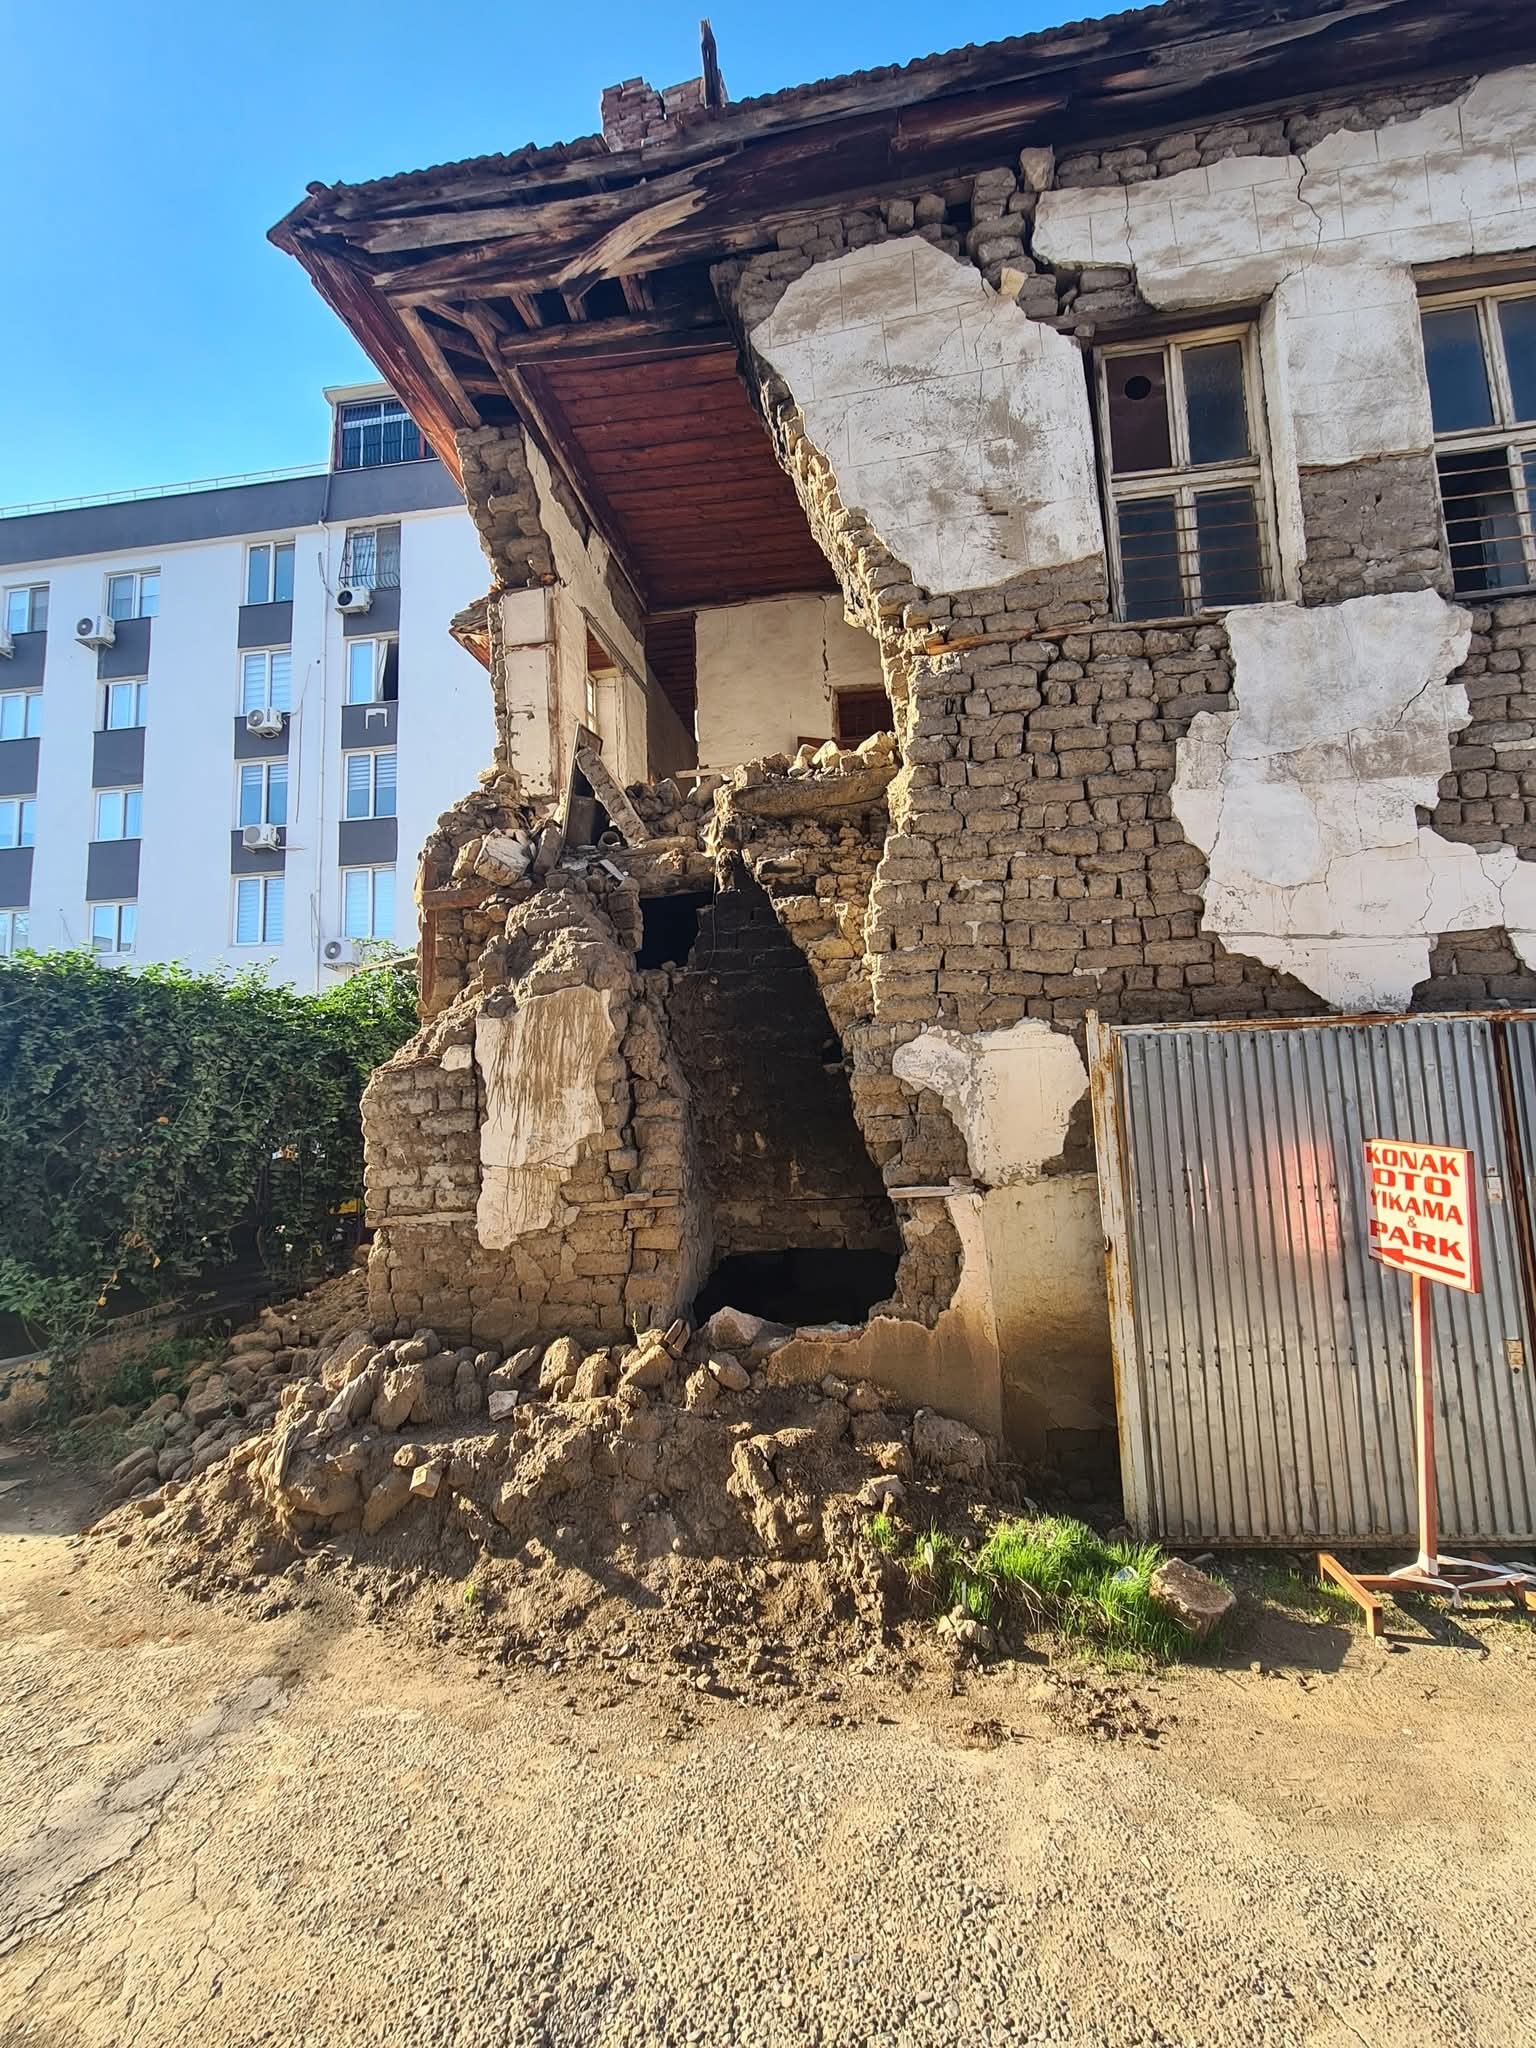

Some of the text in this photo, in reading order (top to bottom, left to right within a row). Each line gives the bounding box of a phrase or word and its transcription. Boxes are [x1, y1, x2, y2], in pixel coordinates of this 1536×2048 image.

[1366, 1146, 1460, 1177] KONAK
[1372, 1168, 1452, 1198] OTO
[1371, 1189, 1464, 1225] YIKAMA
[1407, 1215, 1418, 1228] &
[1370, 1219, 1465, 1262] PARK
